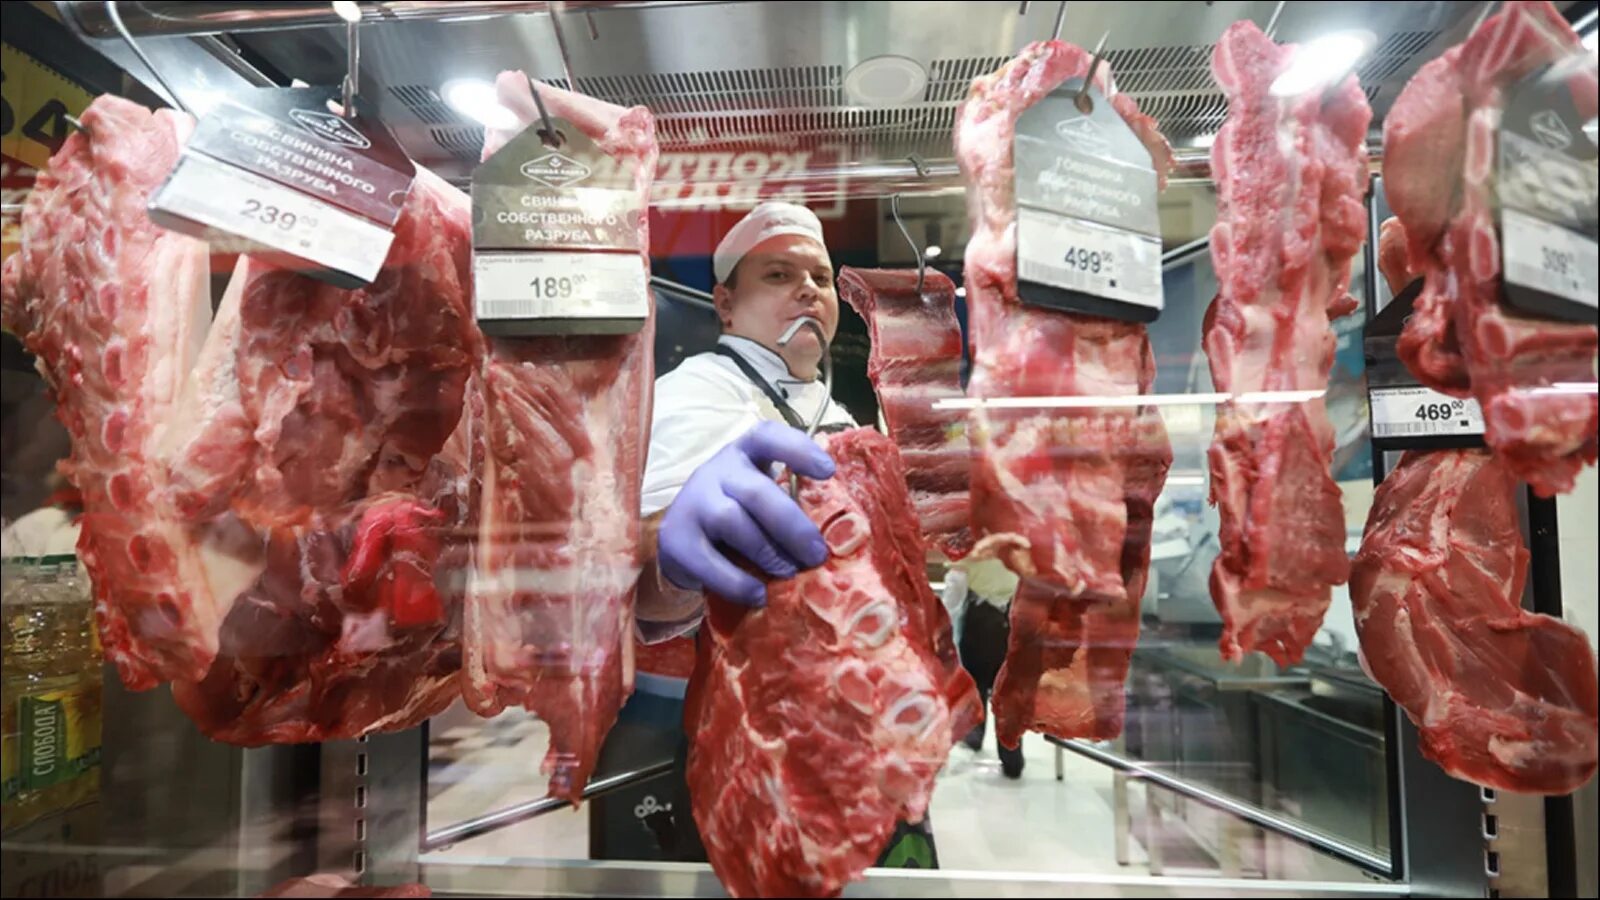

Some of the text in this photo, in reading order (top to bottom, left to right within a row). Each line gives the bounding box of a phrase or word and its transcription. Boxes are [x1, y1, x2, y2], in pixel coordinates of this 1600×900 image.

[230, 130, 376, 195] СОБСТВЕННОГО
[268, 124, 354, 171] СВИНИНА
[256, 154, 339, 196] РАЗРУБА
[239, 199, 298, 232] 239
[524, 228, 593, 241] РАЗРУБА
[1064, 246, 1101, 275] 499
[530, 277, 573, 299] 189
[1415, 403, 1452, 421] 469
